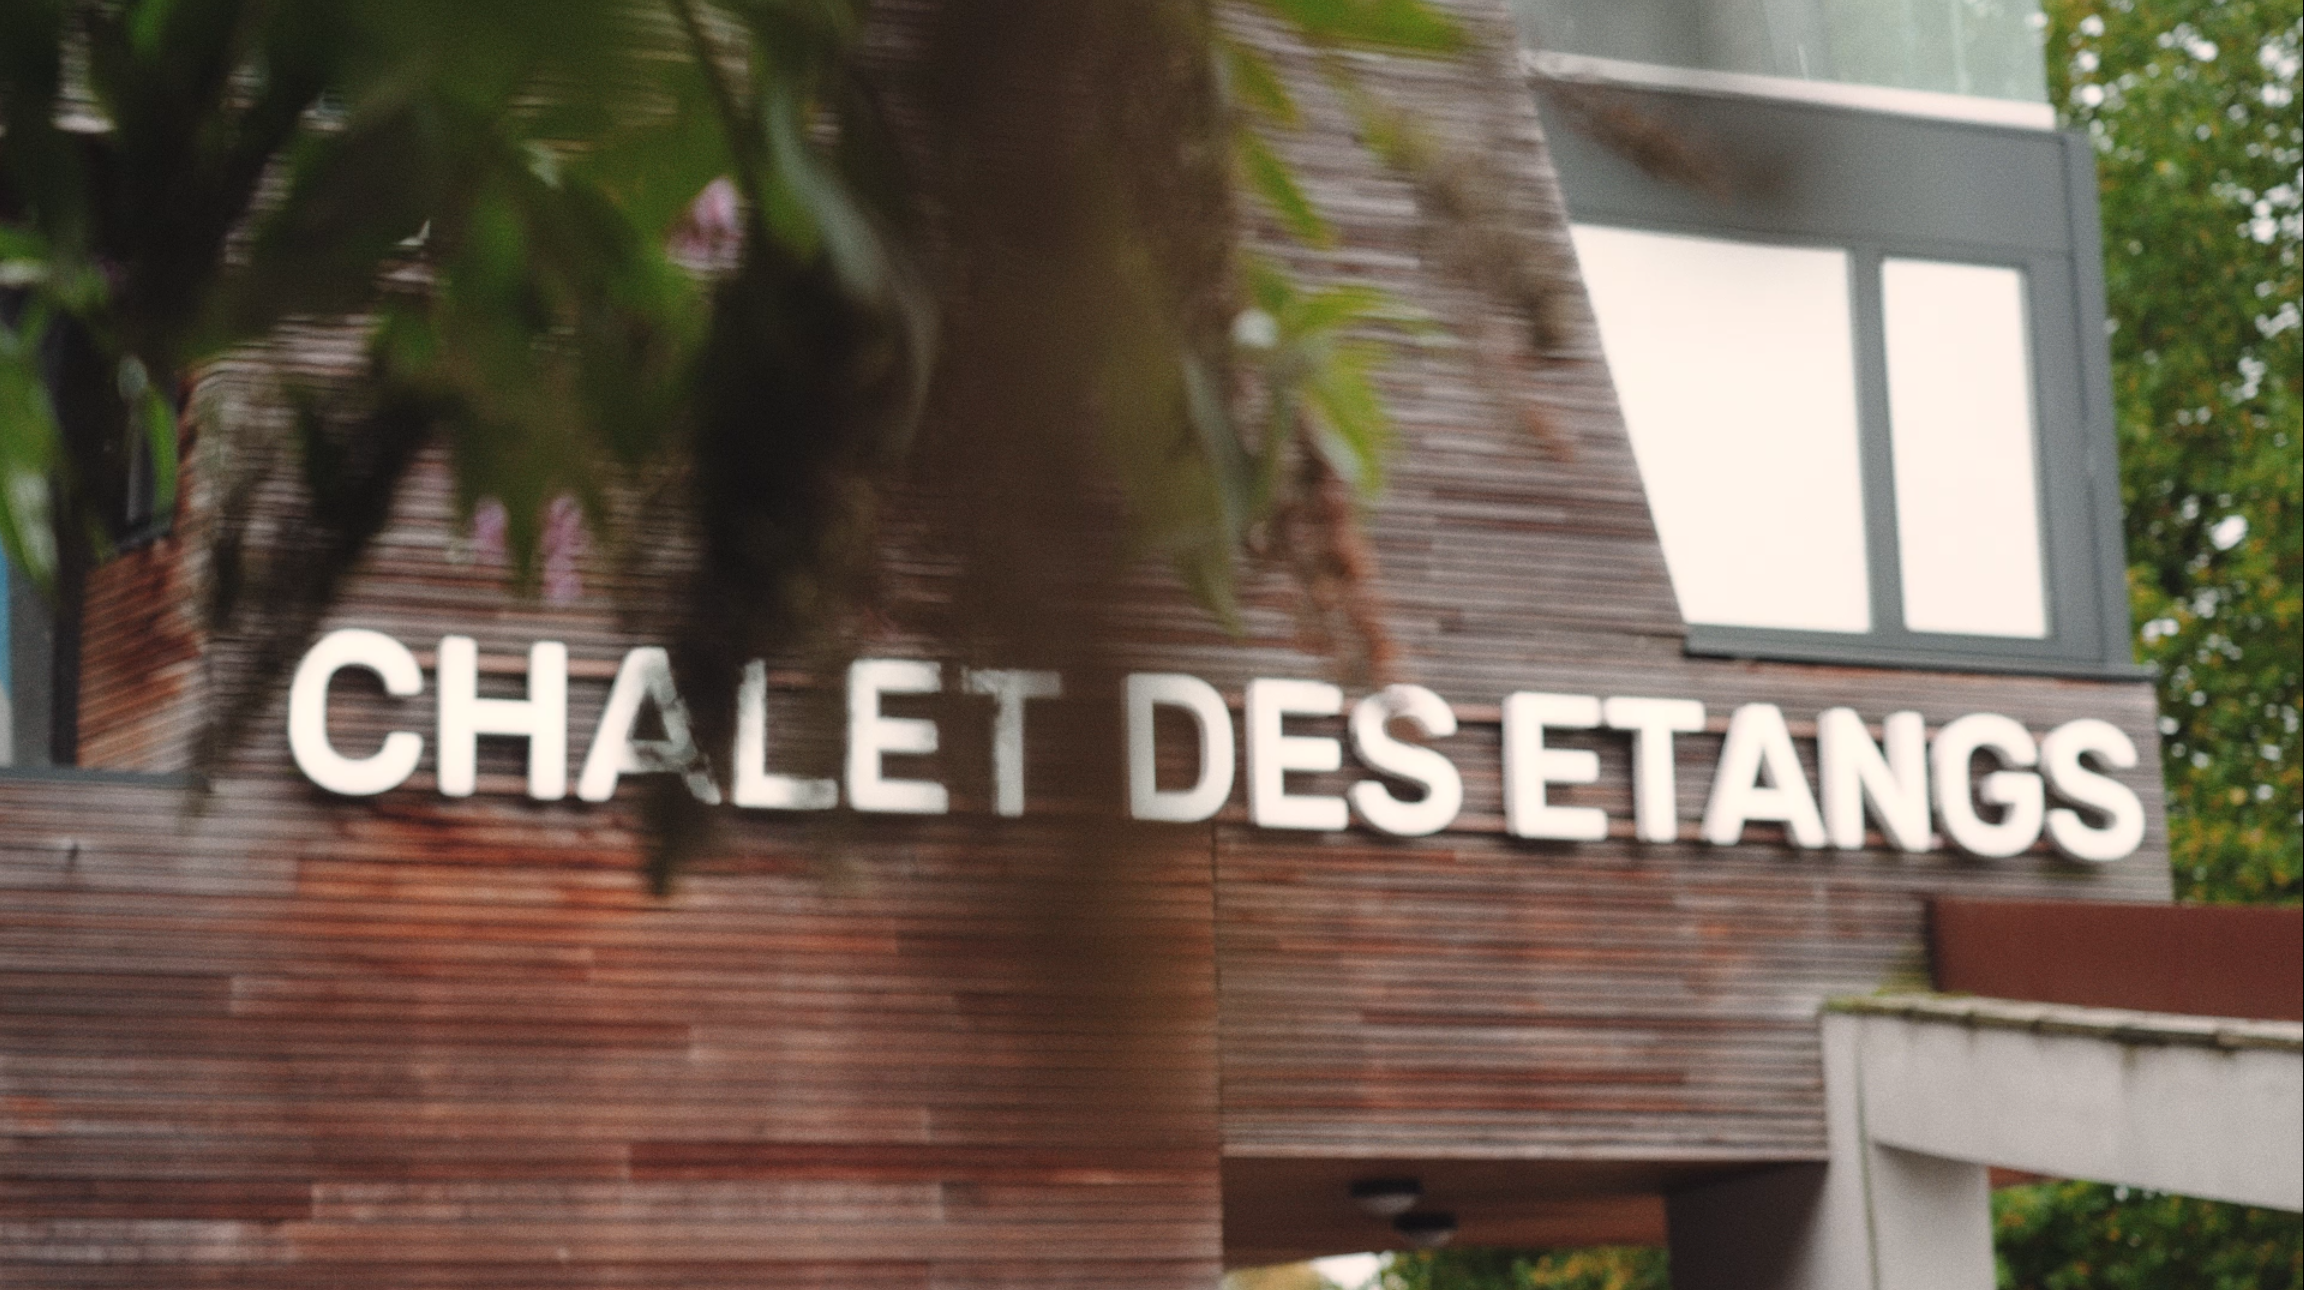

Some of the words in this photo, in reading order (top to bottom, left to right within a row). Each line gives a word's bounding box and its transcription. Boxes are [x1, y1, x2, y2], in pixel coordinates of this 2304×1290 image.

[288, 628, 1063, 818] CHALET
[1125, 672, 1463, 836] DES
[1502, 691, 2147, 862] ETANGS
